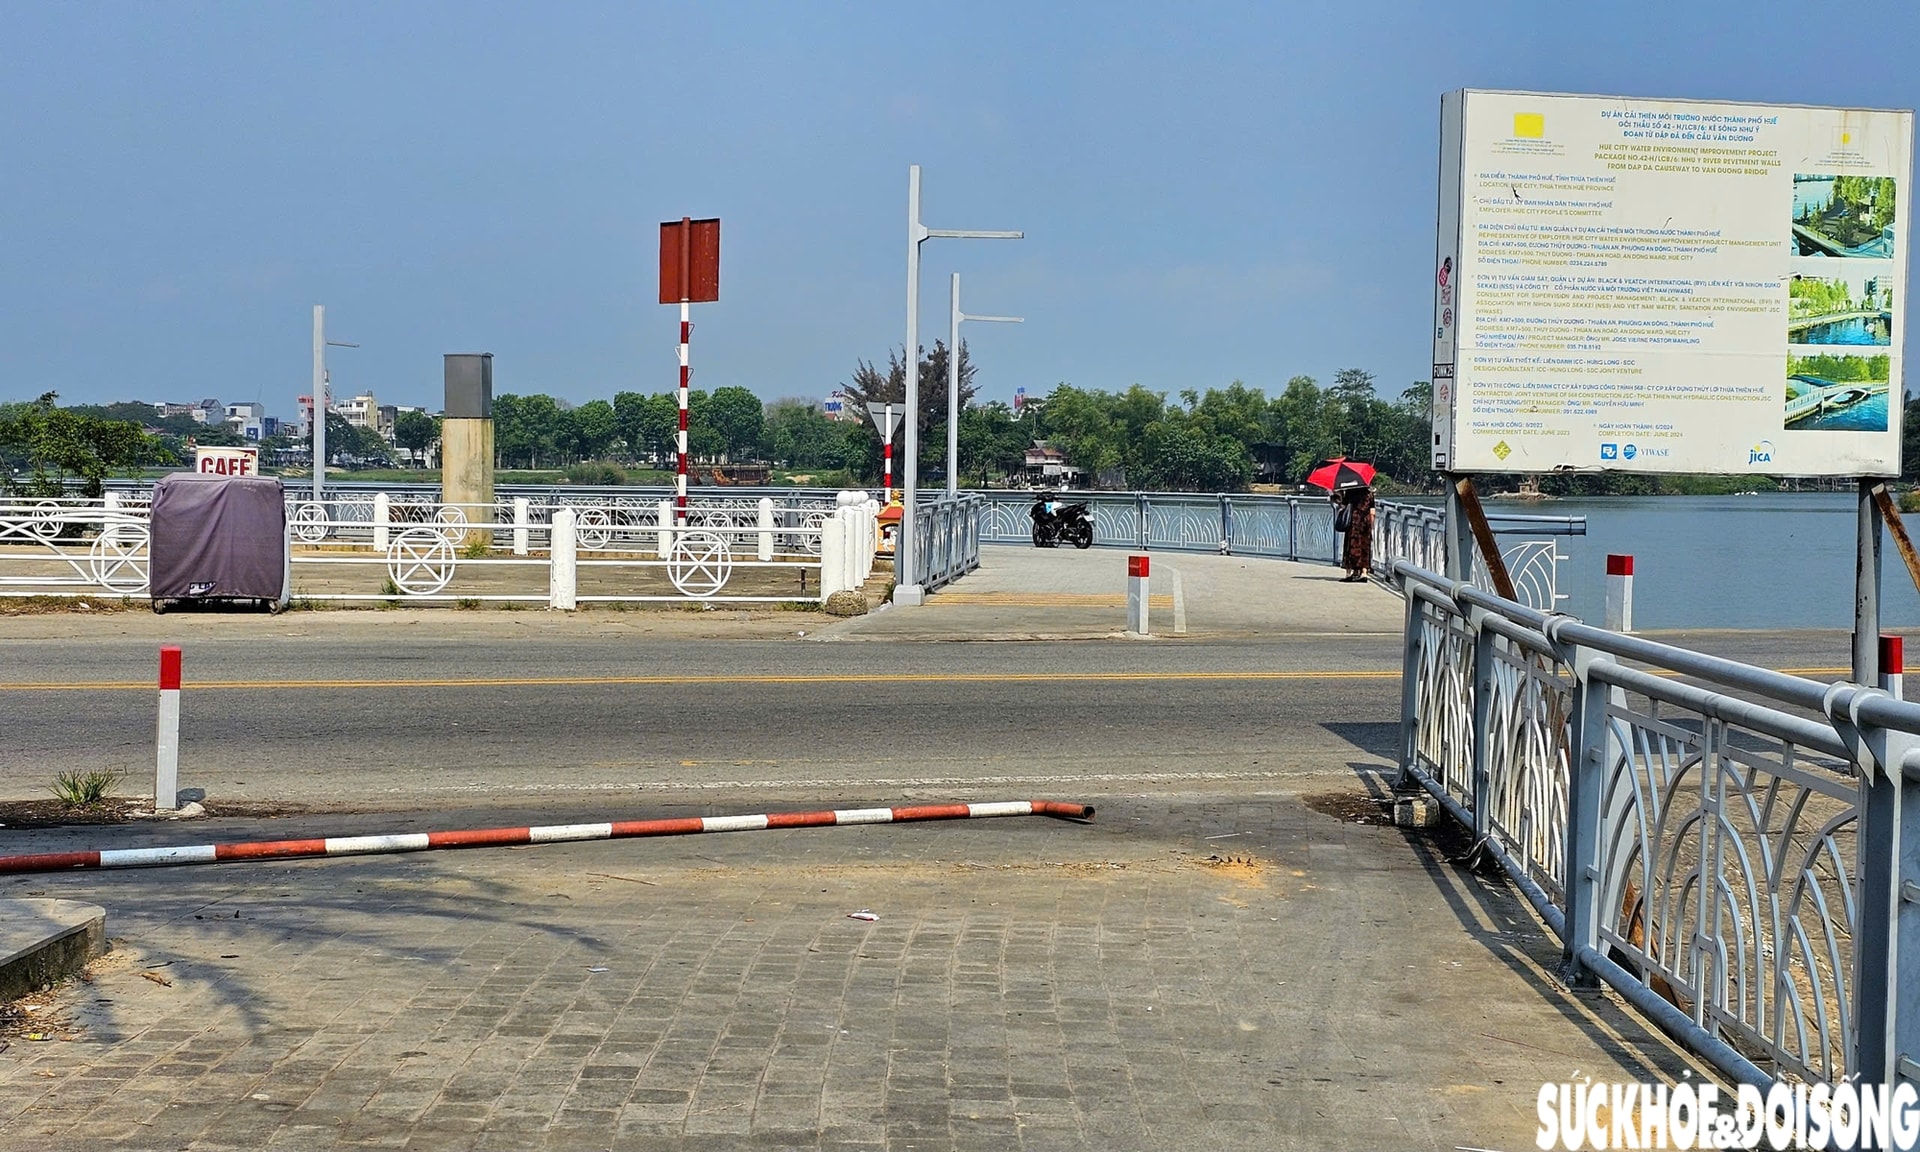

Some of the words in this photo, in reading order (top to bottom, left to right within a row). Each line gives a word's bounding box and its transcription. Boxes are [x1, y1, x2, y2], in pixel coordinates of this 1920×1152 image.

[1653, 145, 1697, 153] ENVIRONMENT
[1700, 147, 1745, 155] IMPROVEMENT
[201, 454, 250, 476] CAFÉ
